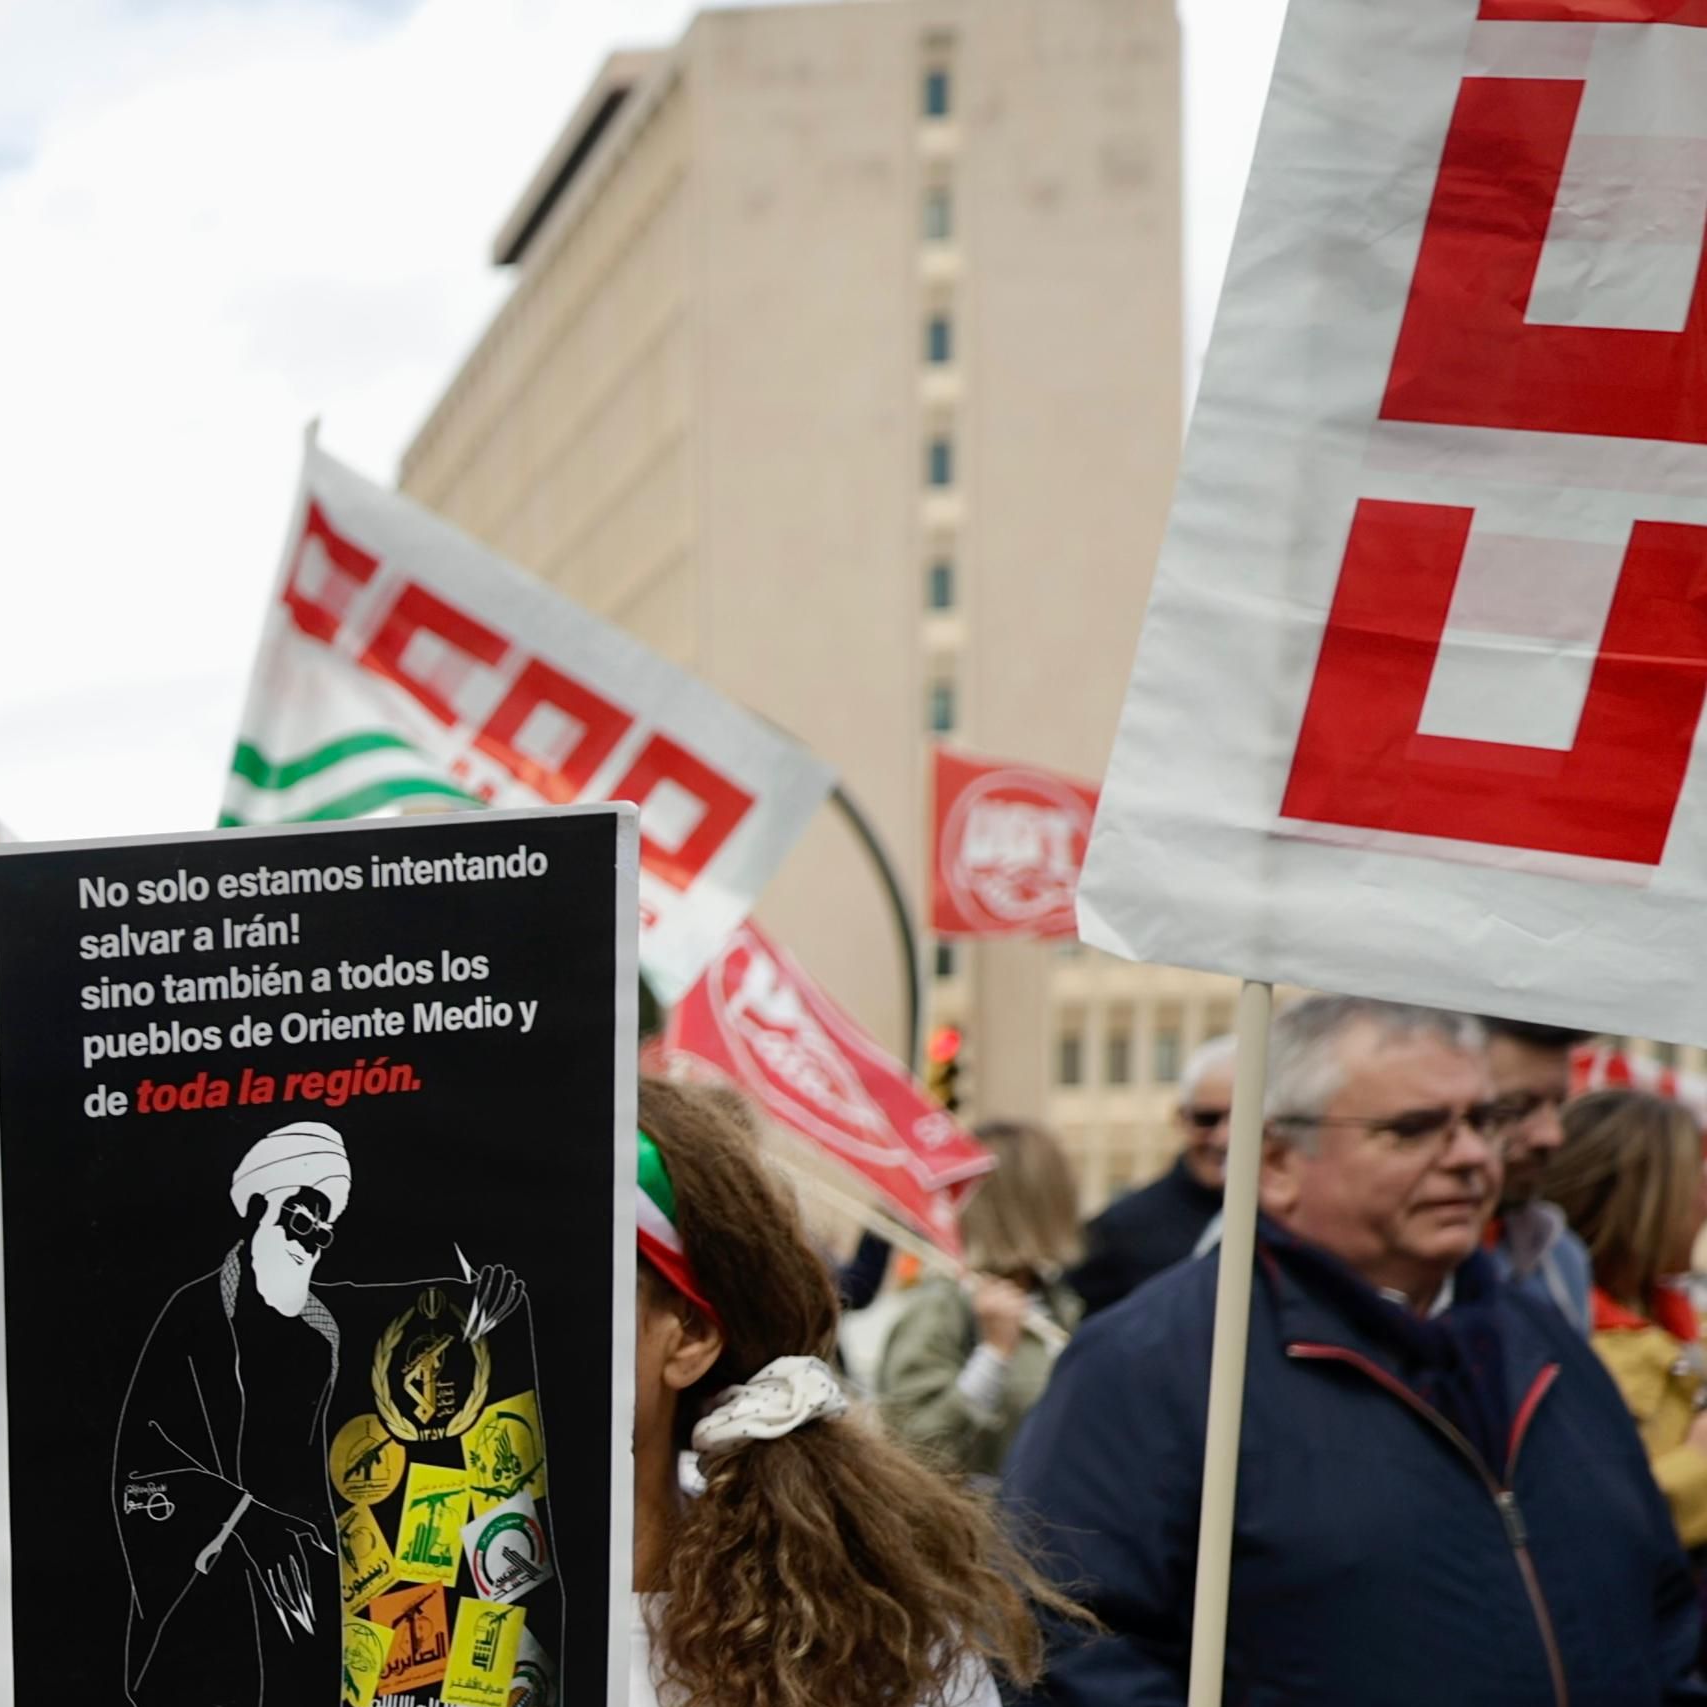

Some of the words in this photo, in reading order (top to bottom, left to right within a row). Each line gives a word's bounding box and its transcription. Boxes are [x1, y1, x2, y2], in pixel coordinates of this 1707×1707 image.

[78, 876, 129, 910] No
[136, 868, 210, 906] solo
[217, 861, 364, 900] estamos
[370, 844, 548, 888] intentando
[79, 923, 186, 961] salvar
[192, 925, 214, 952] a
[222, 912, 301, 949] Irán!
[80, 976, 155, 1011] sino
[162, 962, 303, 1005] también
[310, 966, 332, 993] a
[338, 954, 434, 991] todos
[441, 949, 490, 982] los
[83, 1020, 223, 1068] pueblos
[229, 1014, 273, 1049] de
[280, 1007, 405, 1045] Oriente
[413, 995, 513, 1035] Medio
[518, 999, 538, 1033] y
[83, 1084, 129, 1118] de
[136, 1071, 230, 1114] toda
[238, 1067, 276, 1106] la
[283, 1055, 423, 1108] región.
